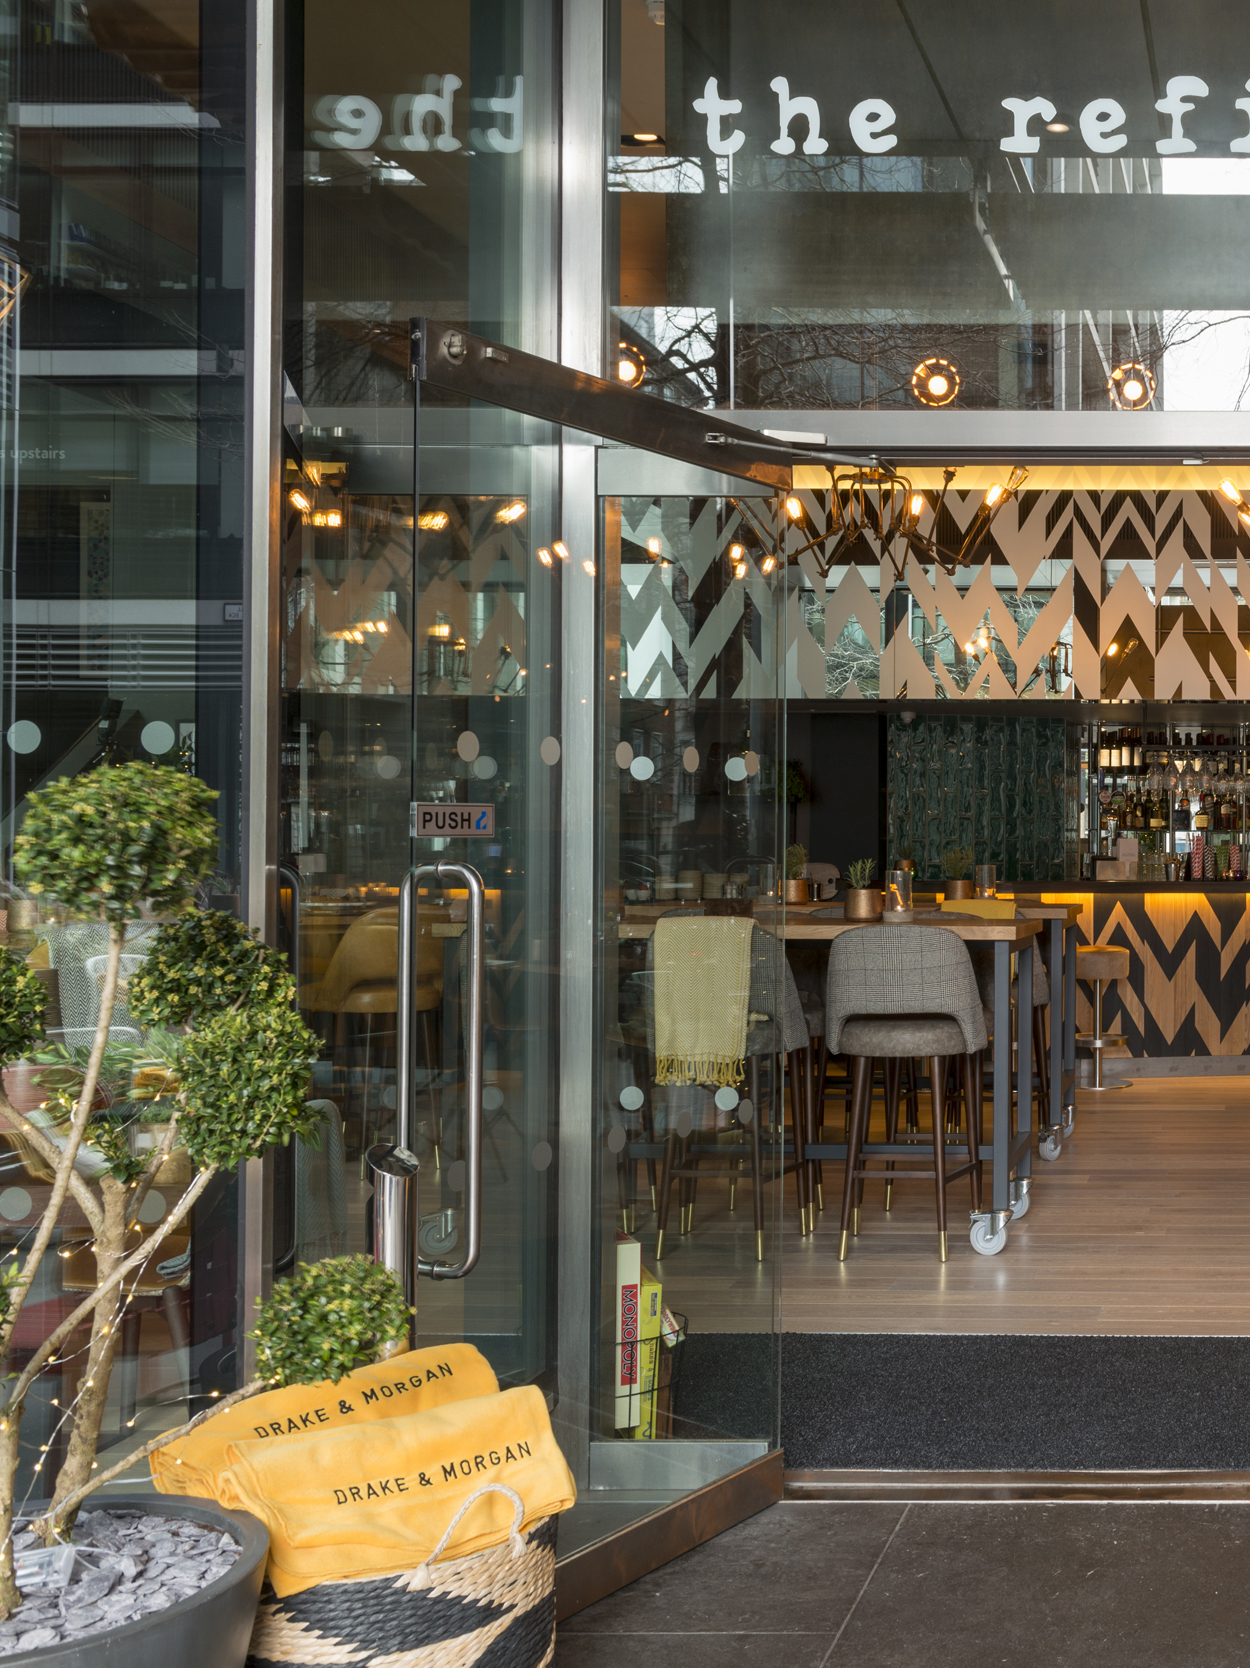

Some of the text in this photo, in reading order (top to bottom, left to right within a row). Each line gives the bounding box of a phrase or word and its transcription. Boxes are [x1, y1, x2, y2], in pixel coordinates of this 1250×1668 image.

[692, 76, 898, 155] the
[10, 445, 66, 464] upstairs
[422, 811, 472, 830] PUSH
[622, 1288, 637, 1378] MONOPOLY
[254, 1362, 454, 1439] DRAKE & MORGAN
[333, 1441, 533, 1505] DRAKE & MORGAN
